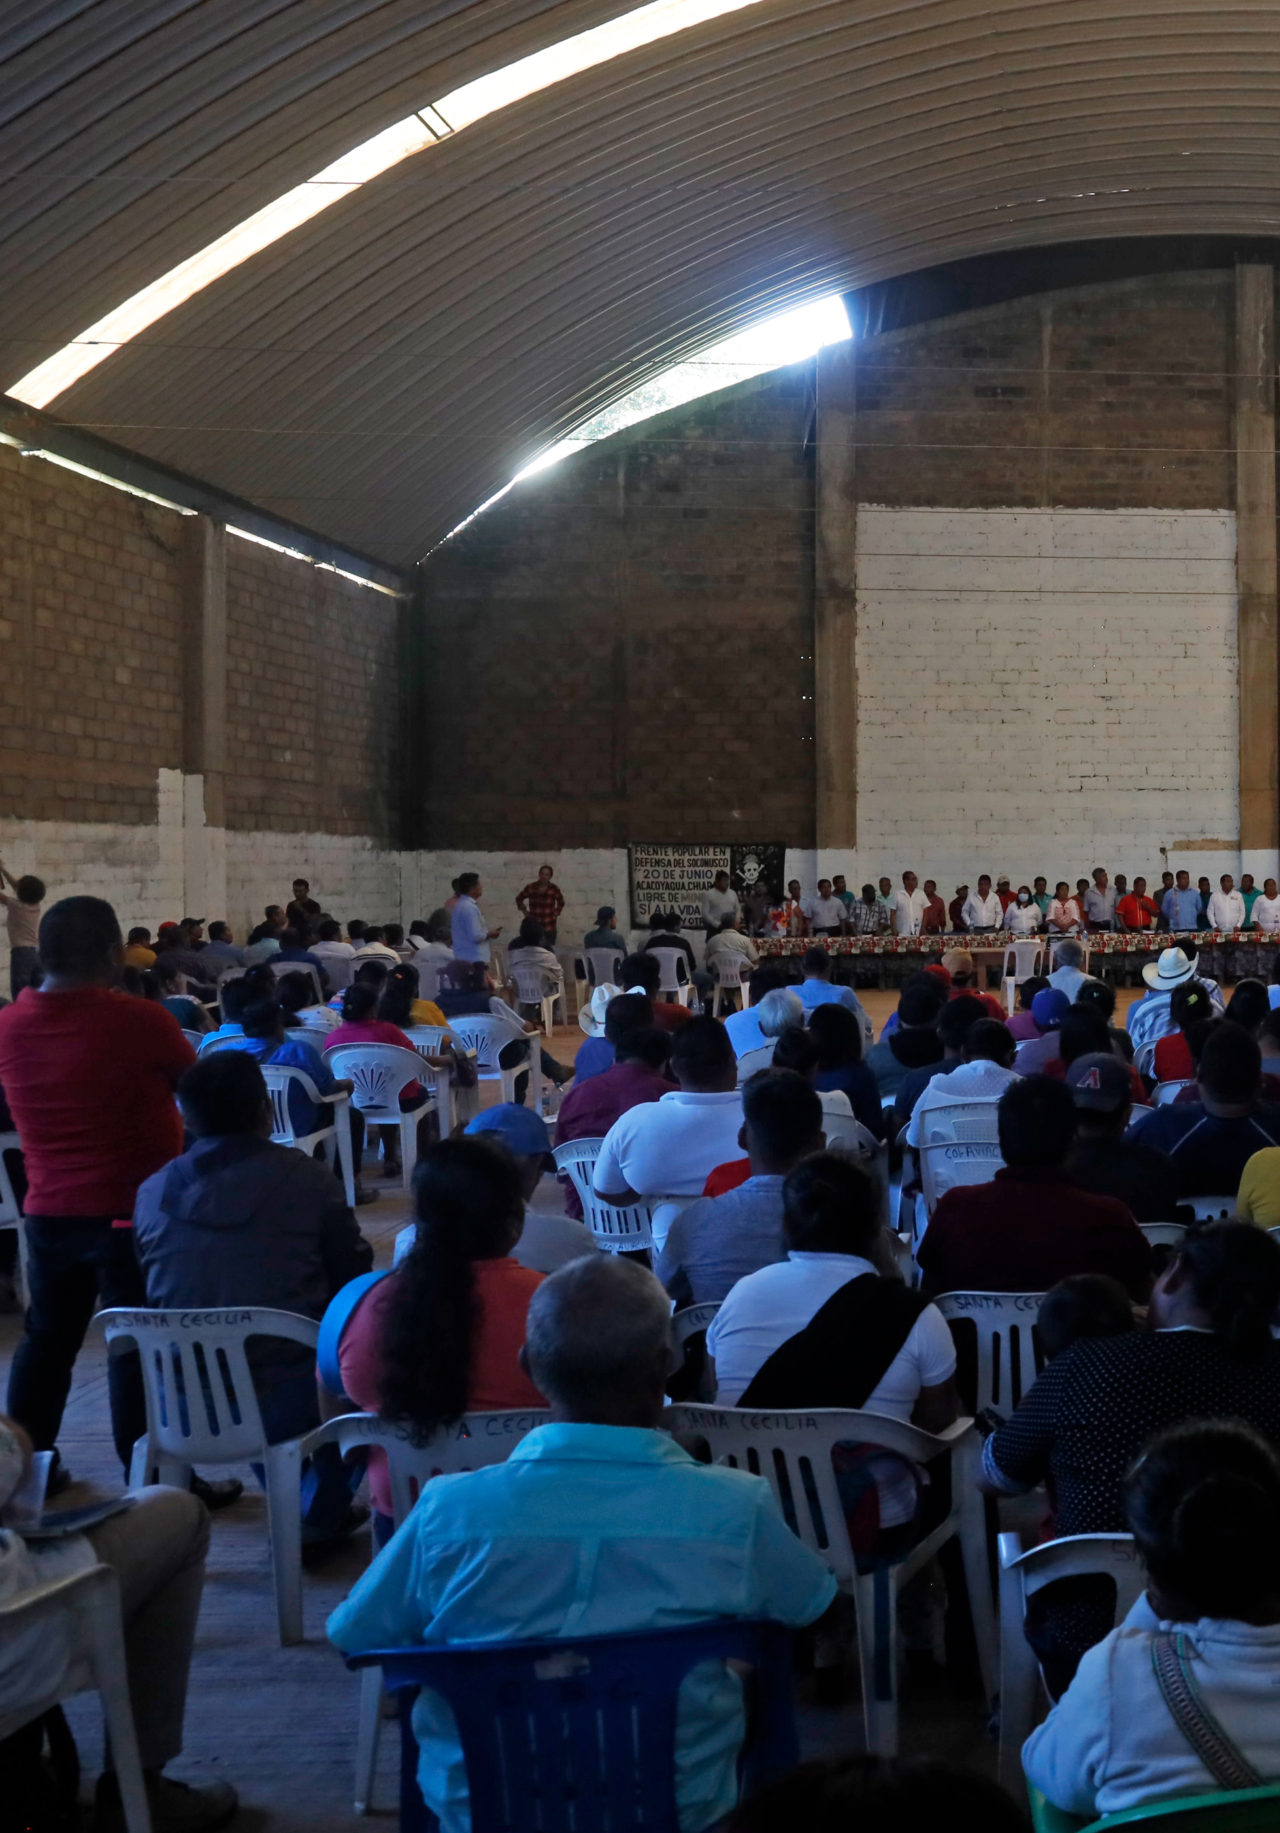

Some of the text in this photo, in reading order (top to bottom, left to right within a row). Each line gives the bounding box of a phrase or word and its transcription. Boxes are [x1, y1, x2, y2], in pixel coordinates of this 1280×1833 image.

[635, 847, 669, 857] FRENTE
[673, 847, 710, 857] POPULAR
[713, 847, 726, 856] EN
[635, 857, 729, 868] DEFENSA DEL SOCONUSCO
[663, 869, 675, 879] DE
[637, 892, 665, 902] LIBRE
[668, 893, 679, 902] DE
[678, 904, 701, 916] VIDA
[954, 1296, 1003, 1310] SANTA
[123, 1312, 169, 1328] SANTA
[180, 1311, 252, 1328] CECILIA
[684, 1409, 818, 1431] SANTA CECILIA
